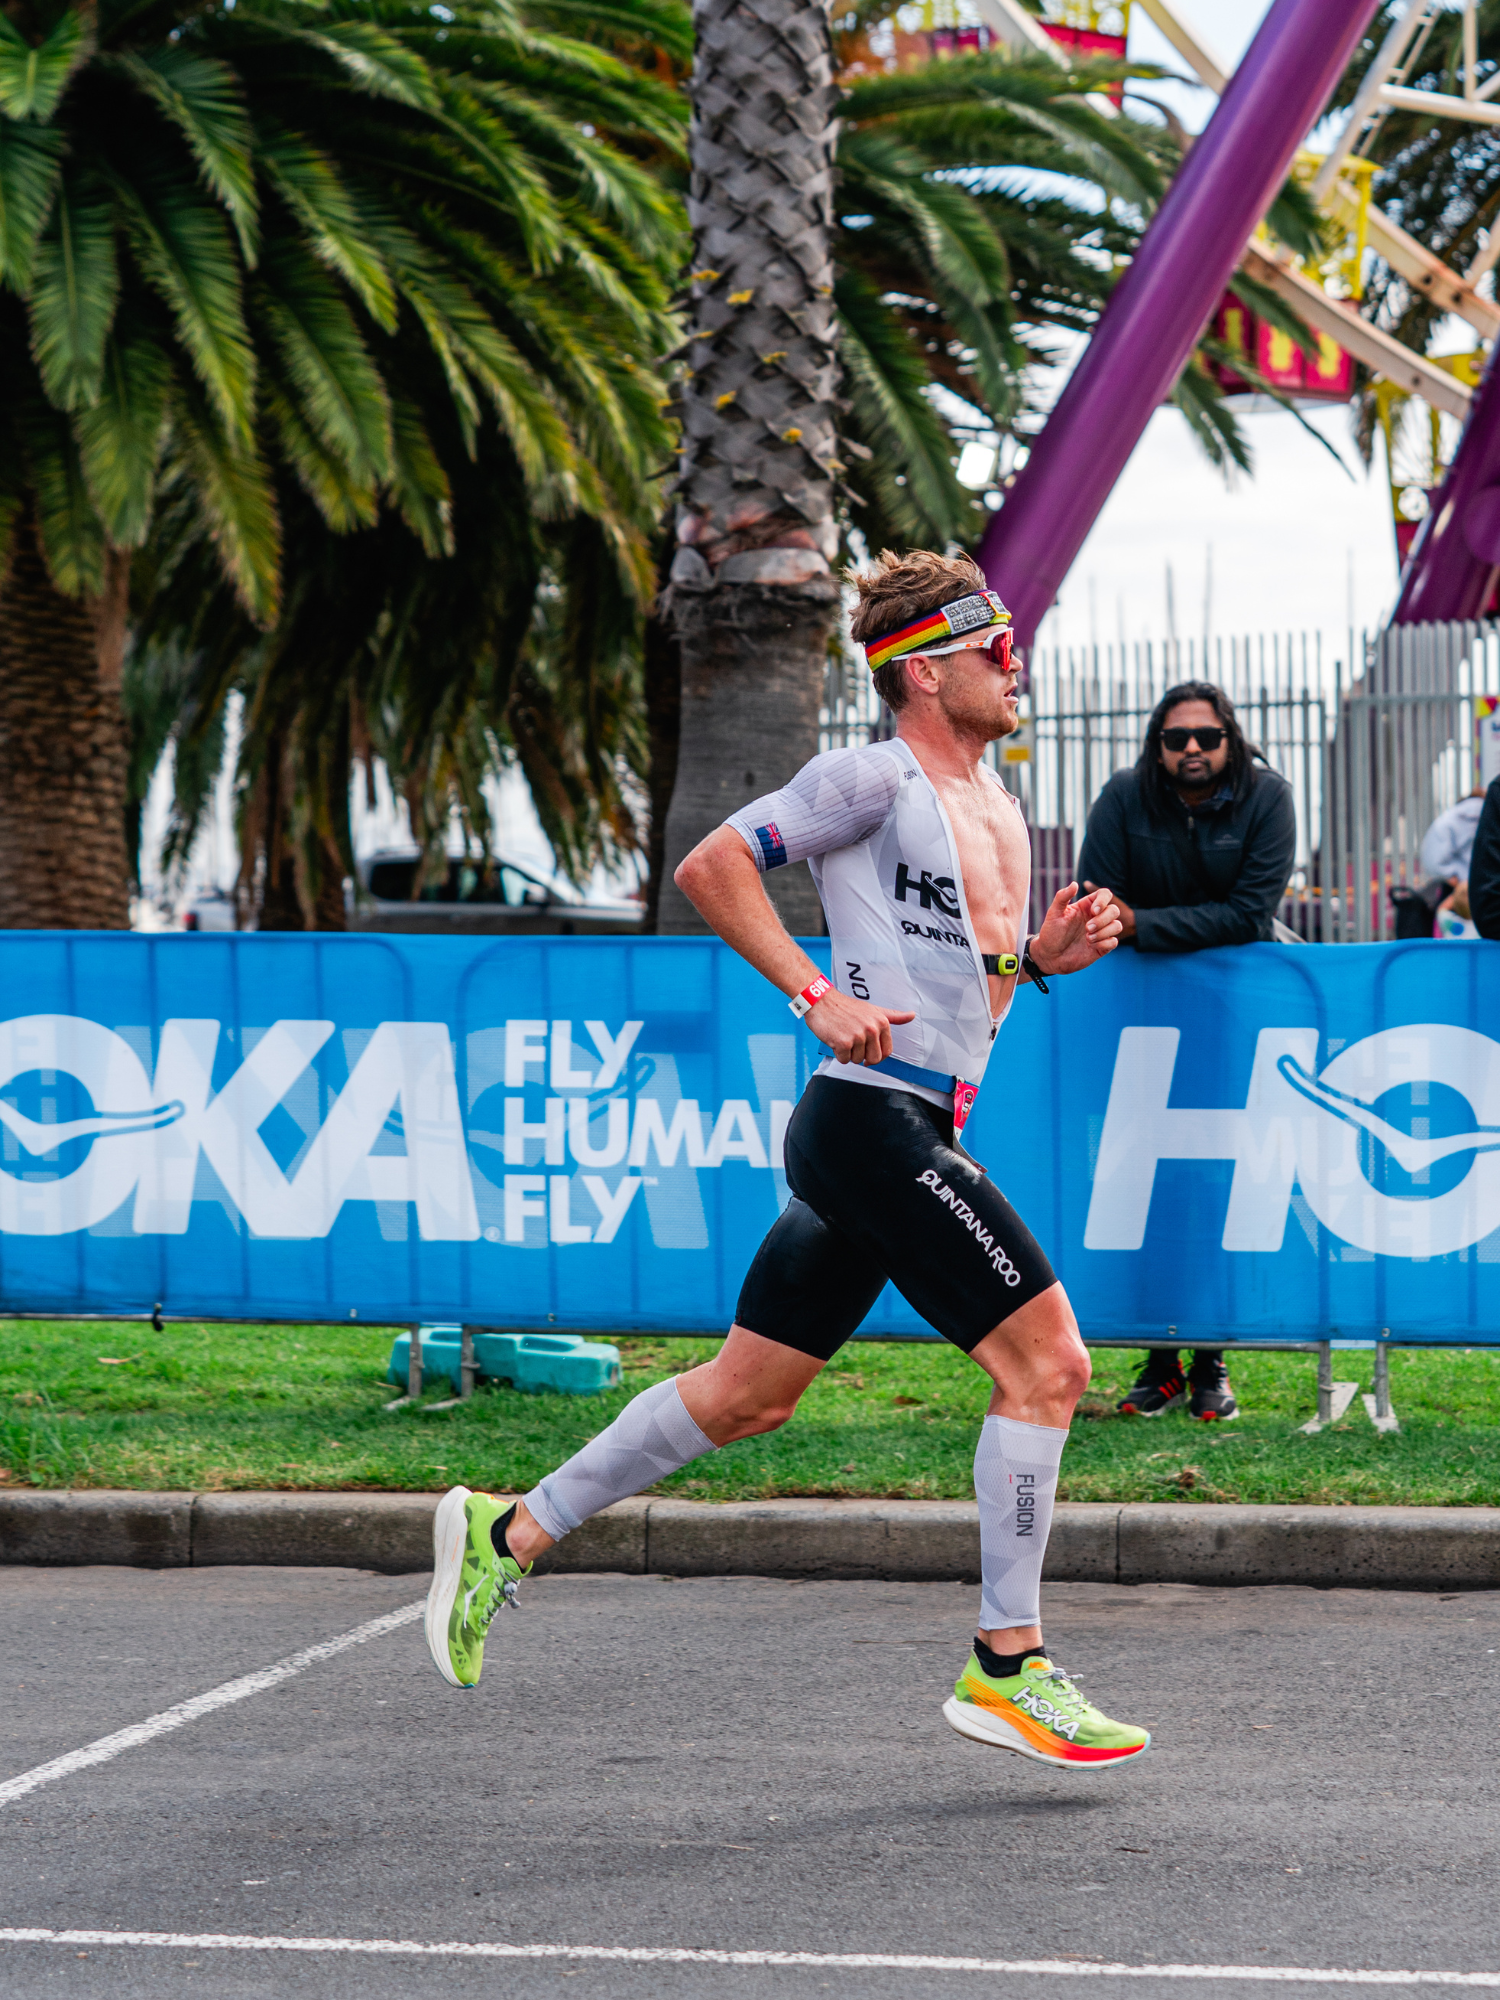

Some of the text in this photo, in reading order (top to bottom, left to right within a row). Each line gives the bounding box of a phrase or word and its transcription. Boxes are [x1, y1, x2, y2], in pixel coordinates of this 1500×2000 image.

[504, 1020, 644, 1088] FLY
[915, 1169, 1021, 1287] QUINTANA ROO
[1016, 1474, 1035, 1537] FUSION
[1011, 1685, 1080, 1741] HOKA
